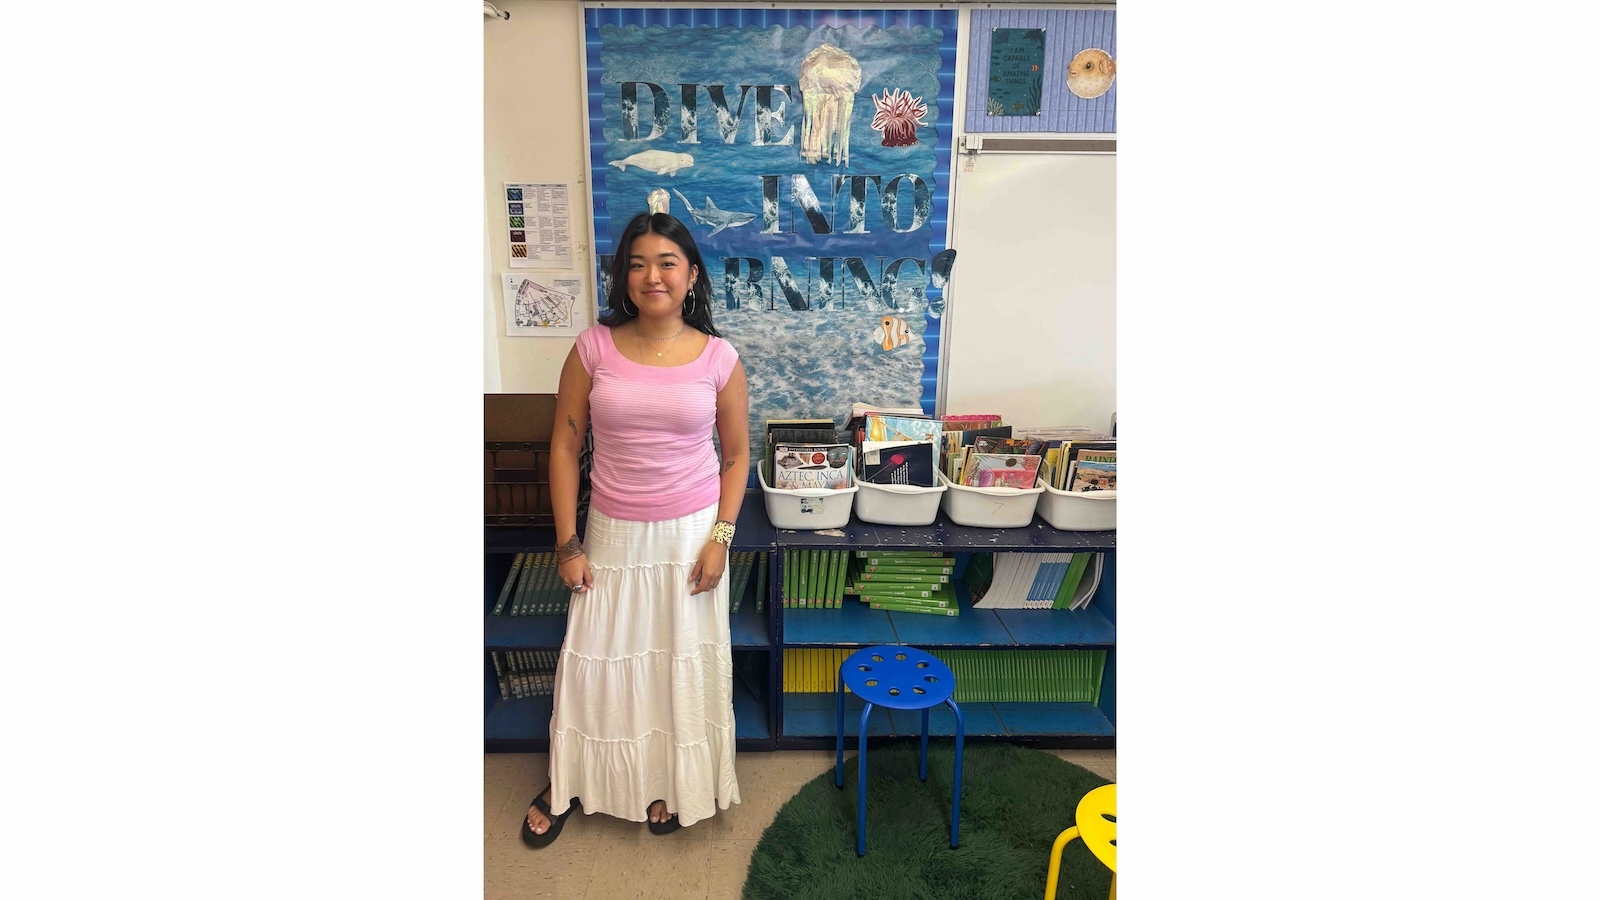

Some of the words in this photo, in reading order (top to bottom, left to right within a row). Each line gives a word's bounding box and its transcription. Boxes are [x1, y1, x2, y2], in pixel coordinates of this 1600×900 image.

[616, 81, 795, 147] DIVE
[758, 173, 931, 235] INTO
[596, 249, 957, 319] RNING!
[790, 481, 799, 489] &
[802, 481, 832, 489] MAYA
[817, 470, 844, 481] INCA
